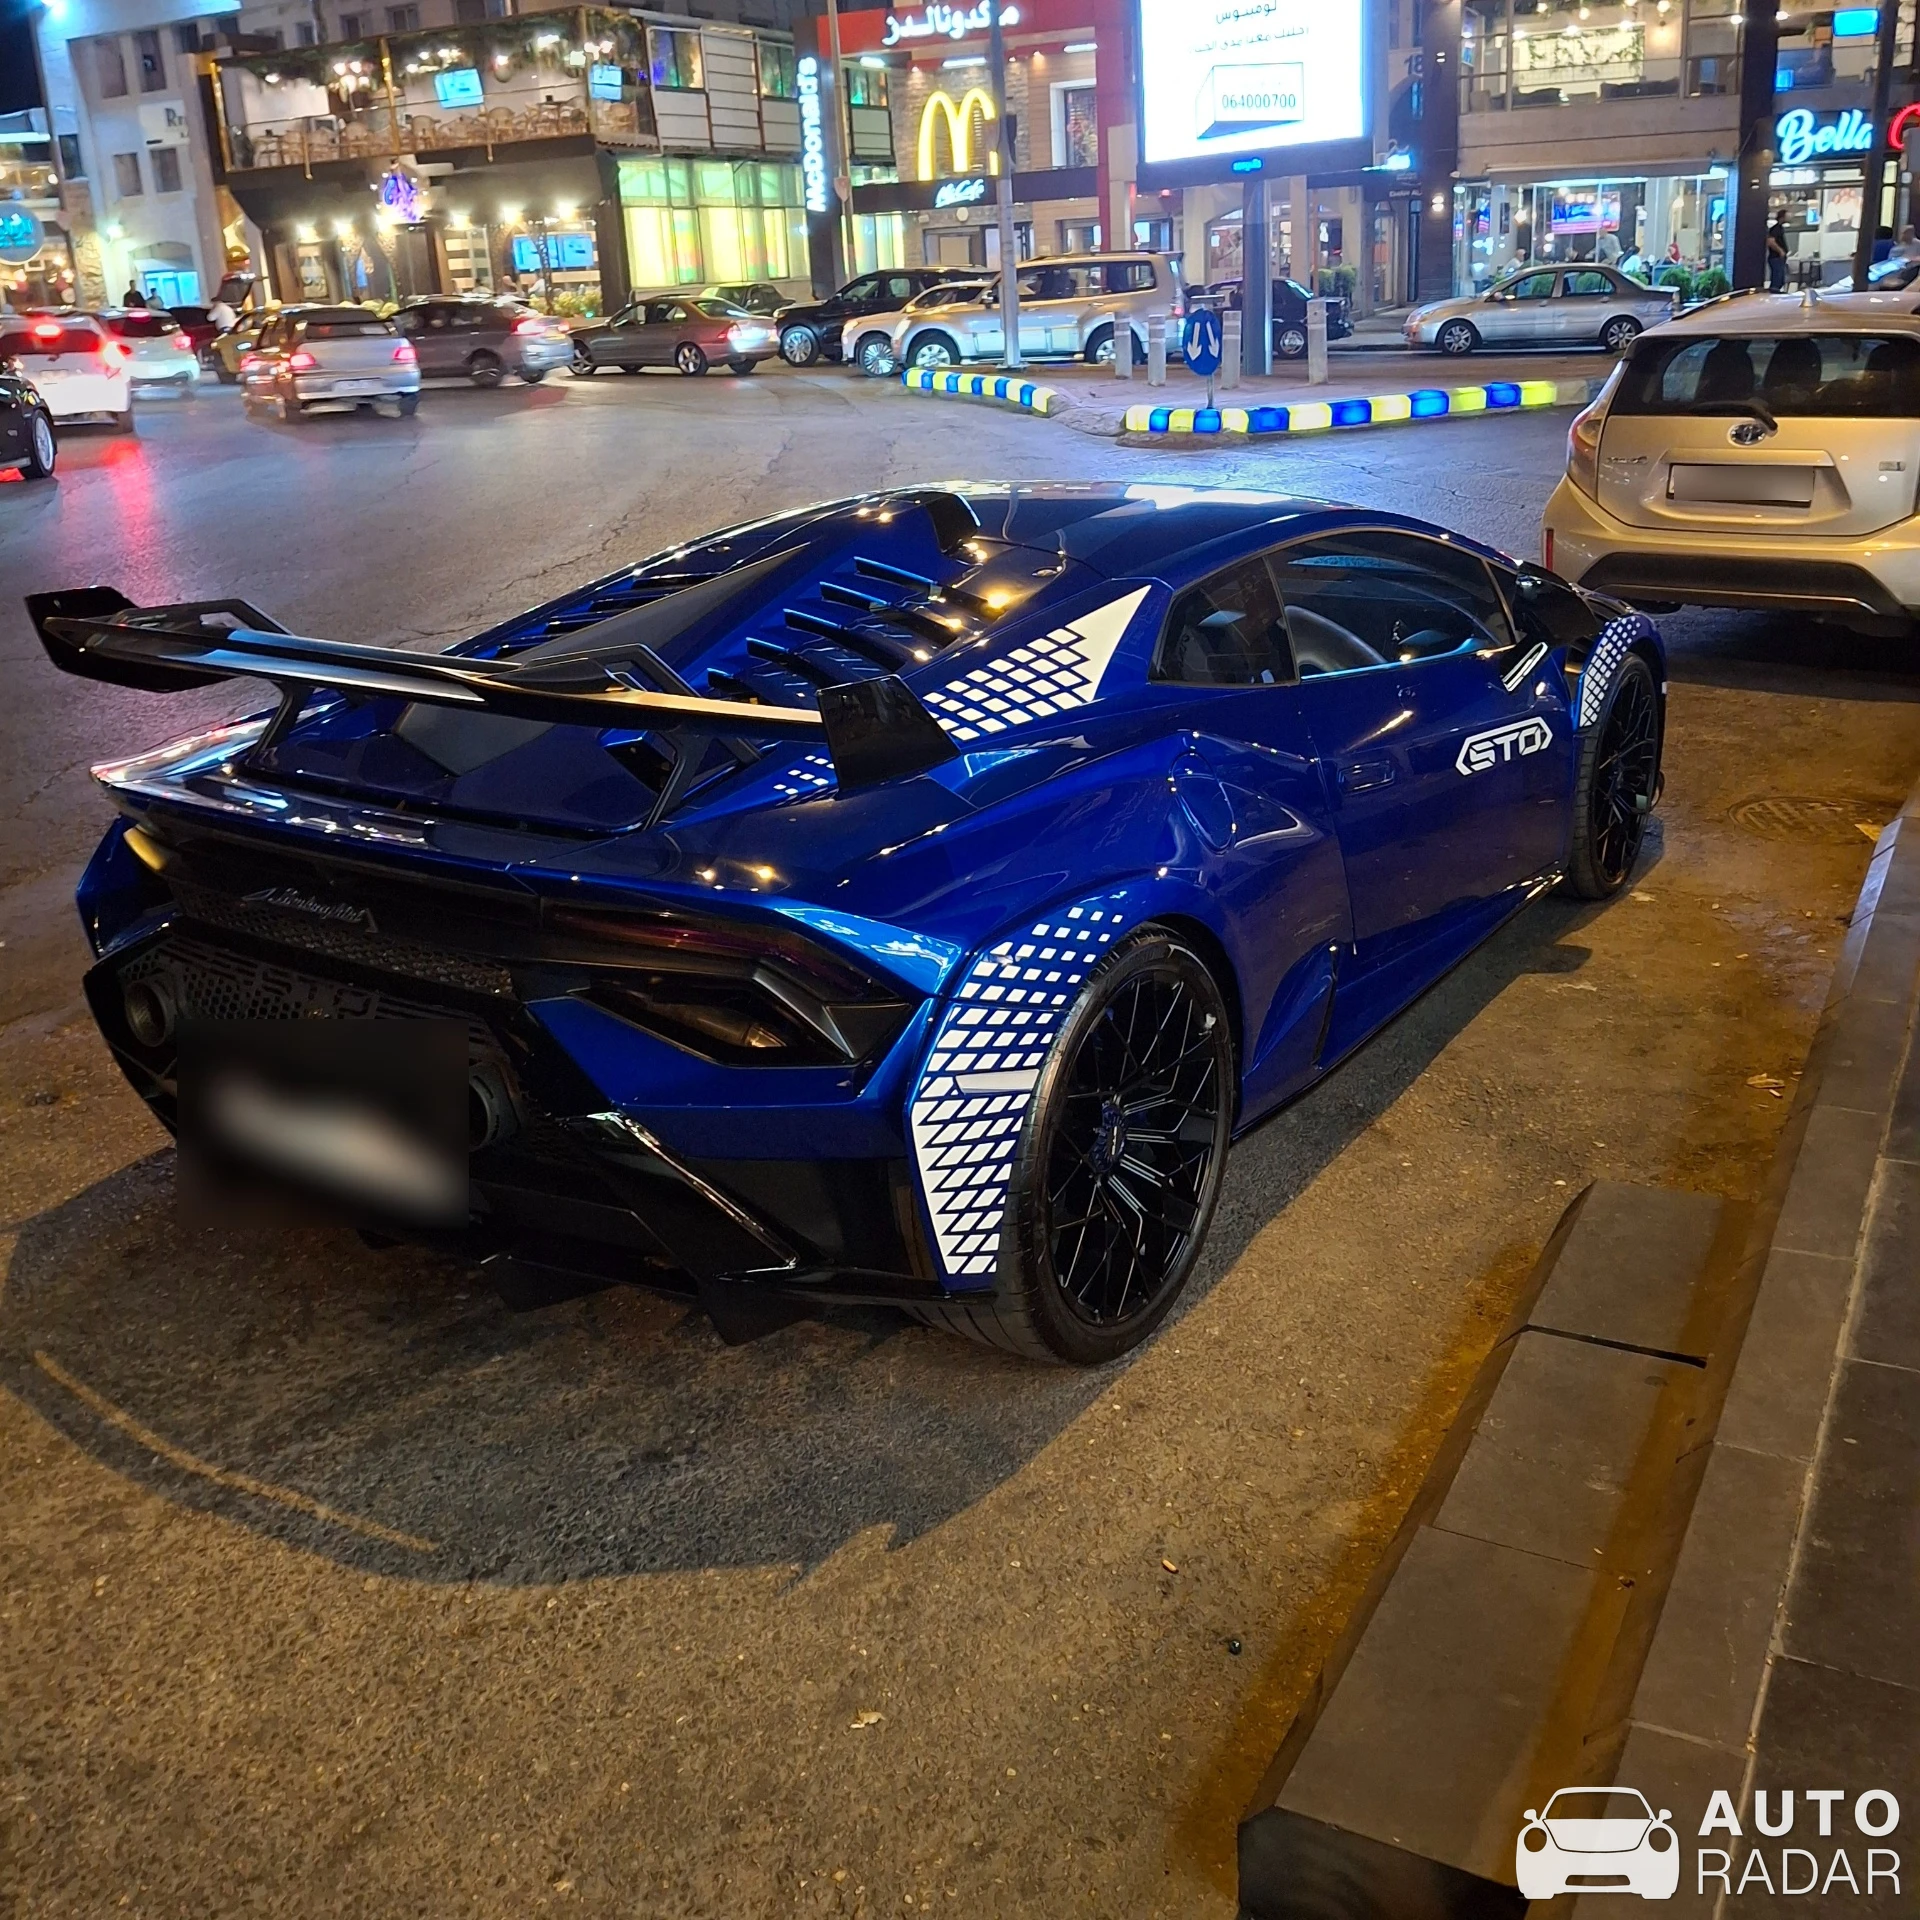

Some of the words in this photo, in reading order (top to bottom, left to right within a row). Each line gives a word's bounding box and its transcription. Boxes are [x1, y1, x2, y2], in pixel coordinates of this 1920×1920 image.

[881, 0, 1020, 46] مكدونالدز
[1776, 108, 1874, 165] Bella
[1469, 724, 1542, 772] STO
